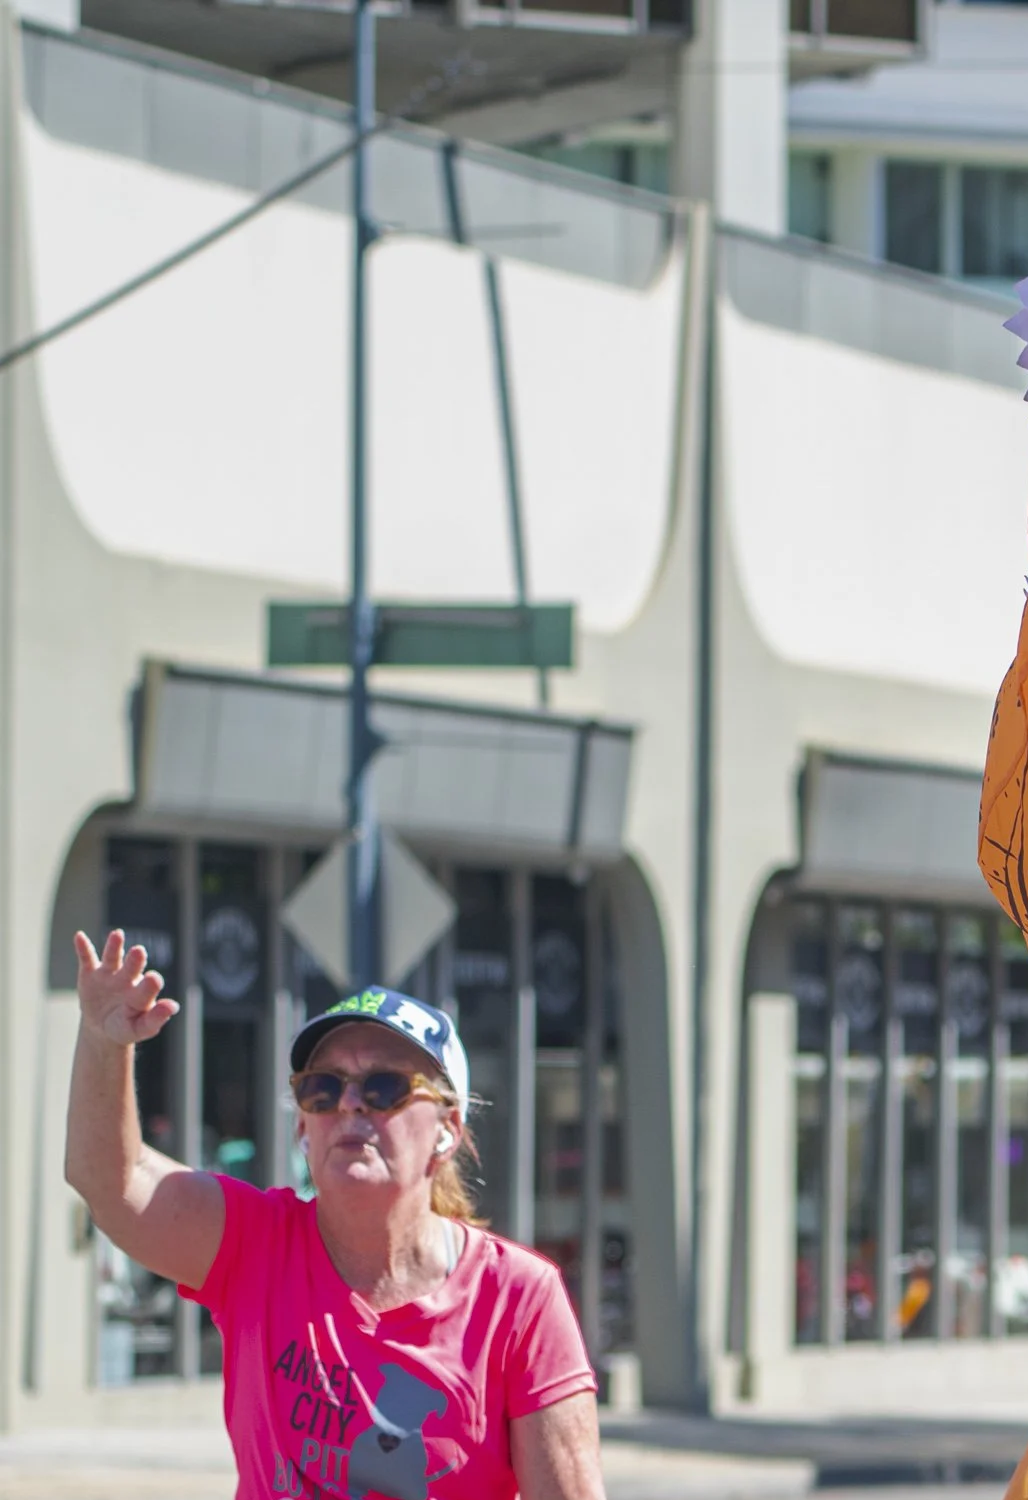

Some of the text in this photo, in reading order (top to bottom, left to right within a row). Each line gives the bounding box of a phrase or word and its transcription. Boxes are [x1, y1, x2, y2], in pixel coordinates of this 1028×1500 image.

[273, 1340, 358, 1406] ANGEL
[290, 1392, 356, 1444] CITY
[300, 1437, 350, 1481] PIT
